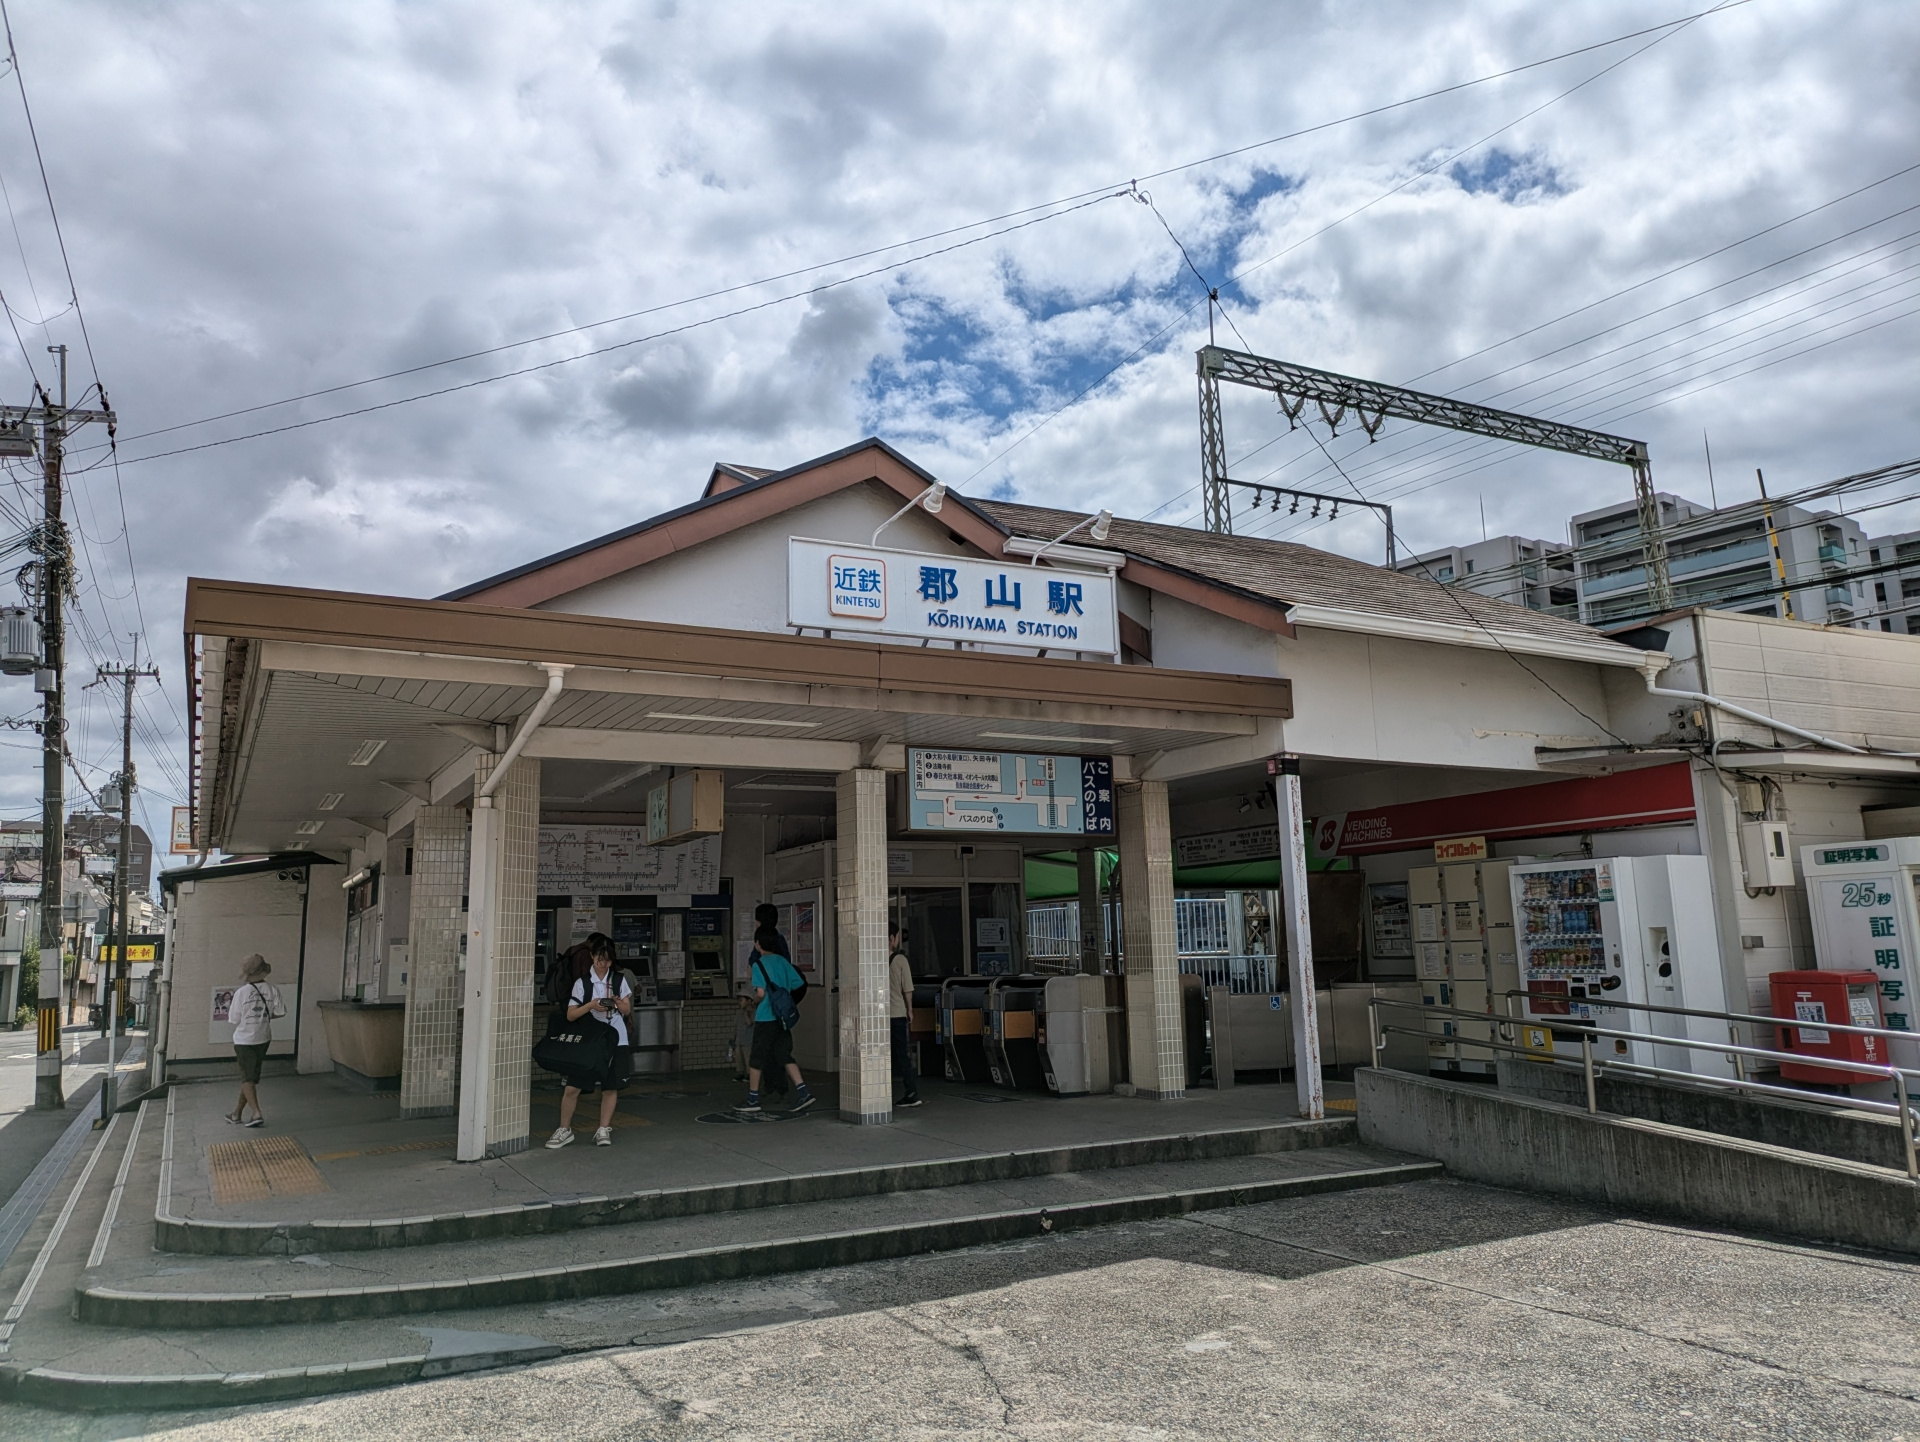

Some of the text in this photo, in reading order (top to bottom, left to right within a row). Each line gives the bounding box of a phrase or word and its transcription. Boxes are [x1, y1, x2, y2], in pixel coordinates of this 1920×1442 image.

[834, 566, 881, 594] 近鉄
[918, 566, 1083, 616] 郡山駅
[835, 595, 881, 608] KINTETSU
[1017, 621, 1078, 639] STATION
[1083, 761, 1098, 830] バスのりば
[1098, 762, 1111, 831] ご案内
[959, 815, 993, 823] バスのりば
[1347, 817, 1387, 831] VENDING
[1345, 828, 1393, 843] MACHINES
[1436, 842, 1484, 859] コインロッカー
[1824, 847, 1879, 864] 証明写真
[1842, 882, 1892, 908] 25秒
[1865, 1053, 1877, 1062] POST
[993, 1068, 1000, 1081] 3
[1048, 1075, 1055, 1087] 4
